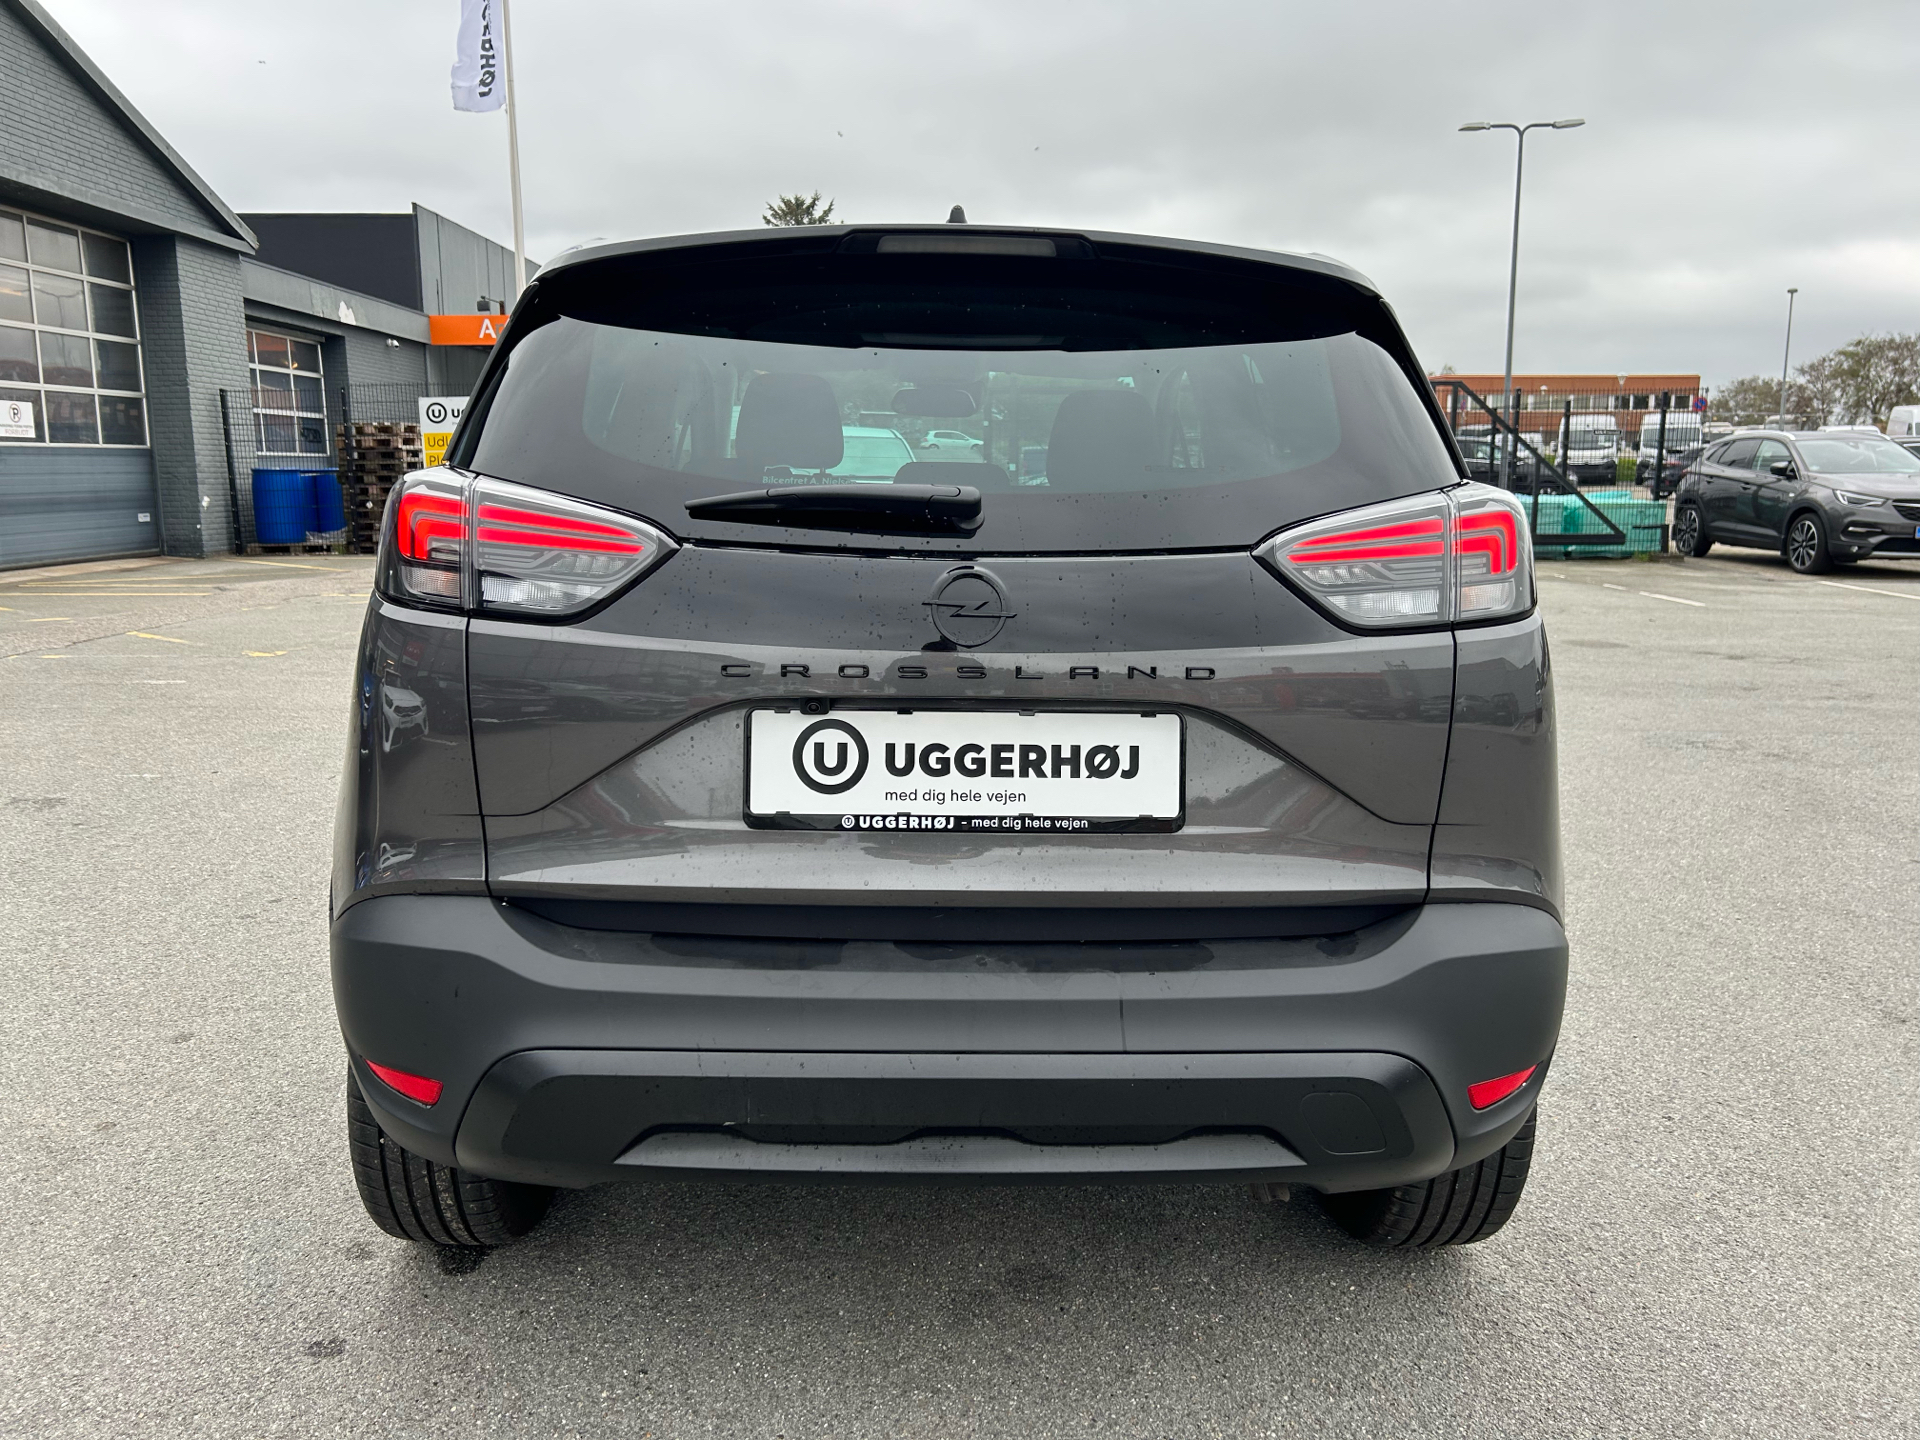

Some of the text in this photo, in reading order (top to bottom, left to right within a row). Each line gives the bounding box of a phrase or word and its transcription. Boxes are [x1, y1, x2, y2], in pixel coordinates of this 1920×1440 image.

[451, 408, 465, 419] U
[762, 476, 807, 485] Bilcentret
[720, 663, 1217, 681] CROSSLAND
[885, 743, 1140, 780] UGGERHØJ
[885, 789, 1026, 806] med dig hele vejen
[859, 816, 955, 829] UGGERHØJ
[971, 817, 999, 828] med
[1001, 817, 1022, 831] dig
[1025, 817, 1052, 828] hele
[1054, 819, 1089, 831] vejen
